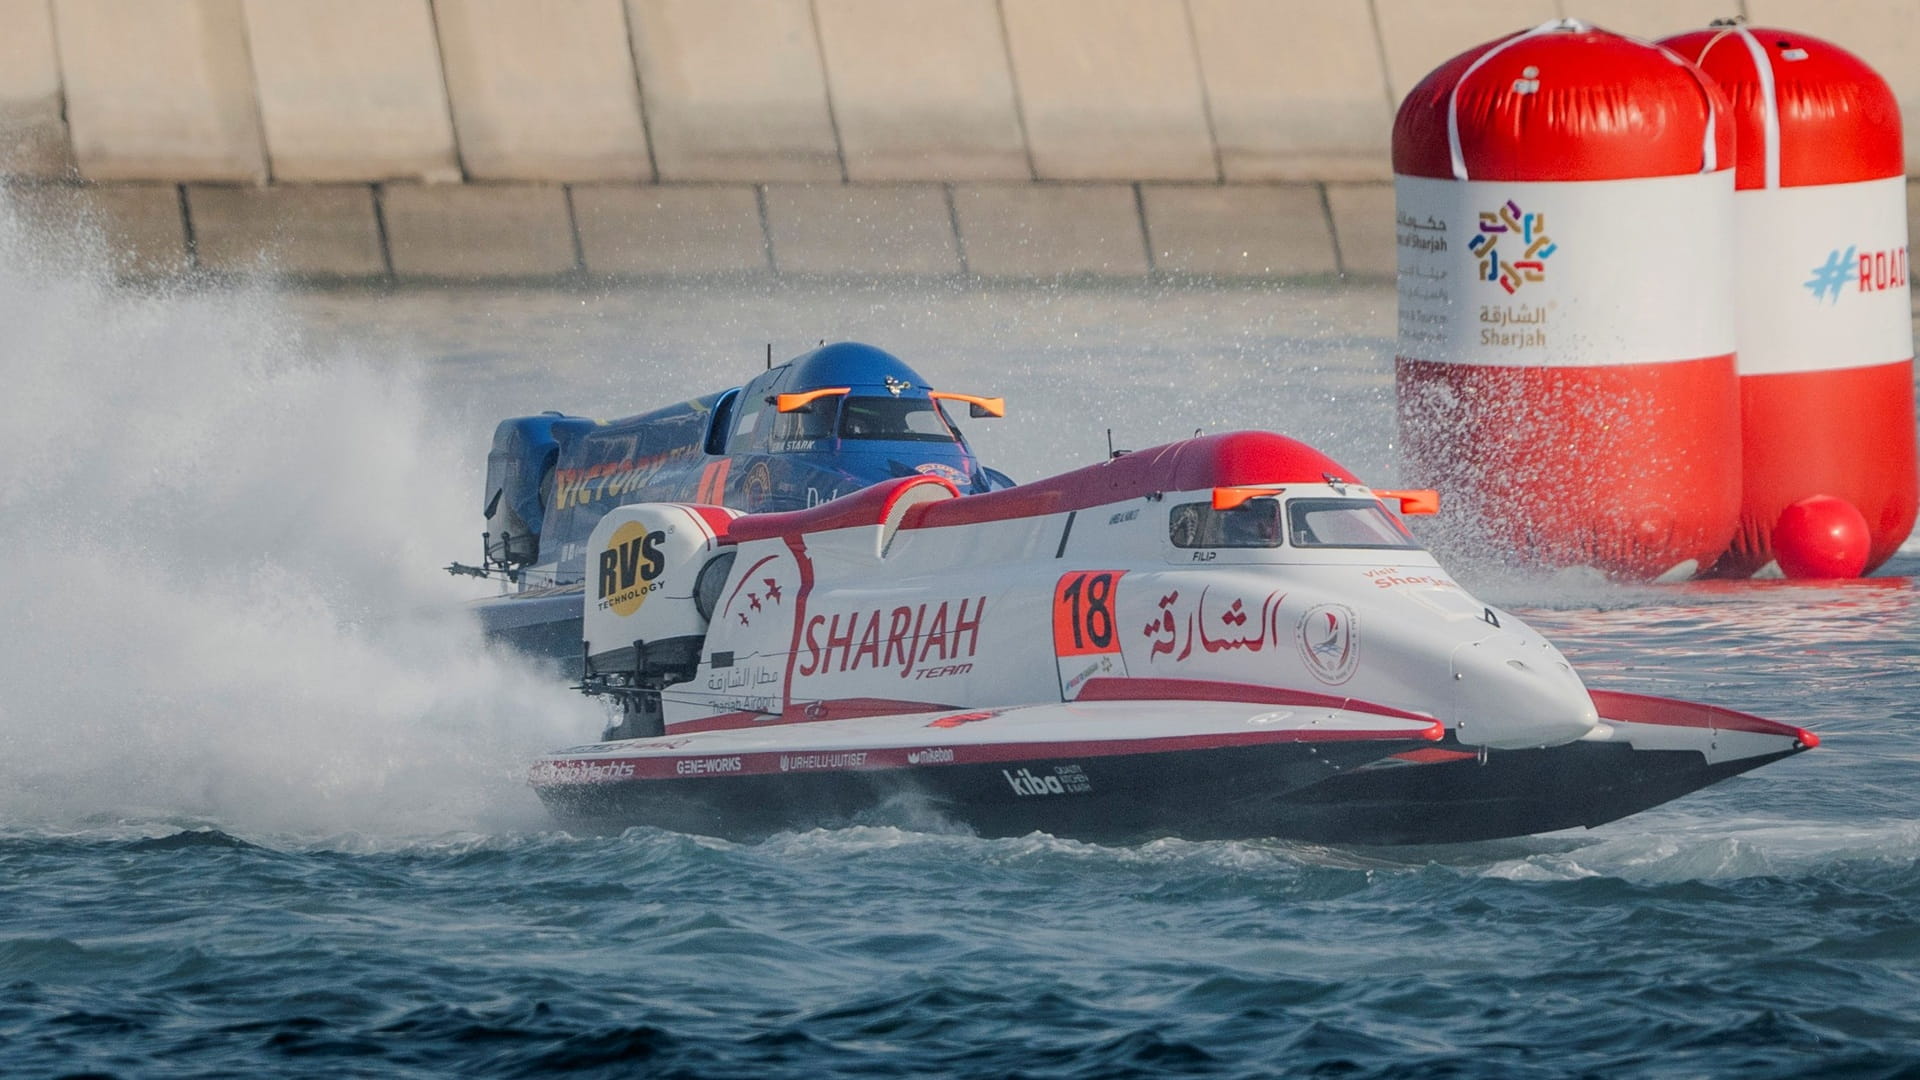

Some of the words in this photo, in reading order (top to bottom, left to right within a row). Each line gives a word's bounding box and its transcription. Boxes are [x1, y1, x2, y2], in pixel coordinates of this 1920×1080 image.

[1803, 244, 1907, 305] #ROAD
[1480, 304, 1546, 327] الشارقة
[1480, 329, 1546, 348] Sharjah
[786, 440, 815, 450] STARK
[598, 530, 666, 600] RVS
[1192, 552, 1217, 561] FILIP
[1362, 568, 1399, 578] visit
[598, 581, 665, 611] TECHNOLOGY
[1064, 574, 1112, 649] 18
[1144, 584, 1288, 664] الشارقة
[800, 596, 987, 679] SHARJAH
[915, 663, 973, 680] TEAM
[677, 757, 741, 774] GENE-WORKS
[1002, 768, 1064, 795] kiba
